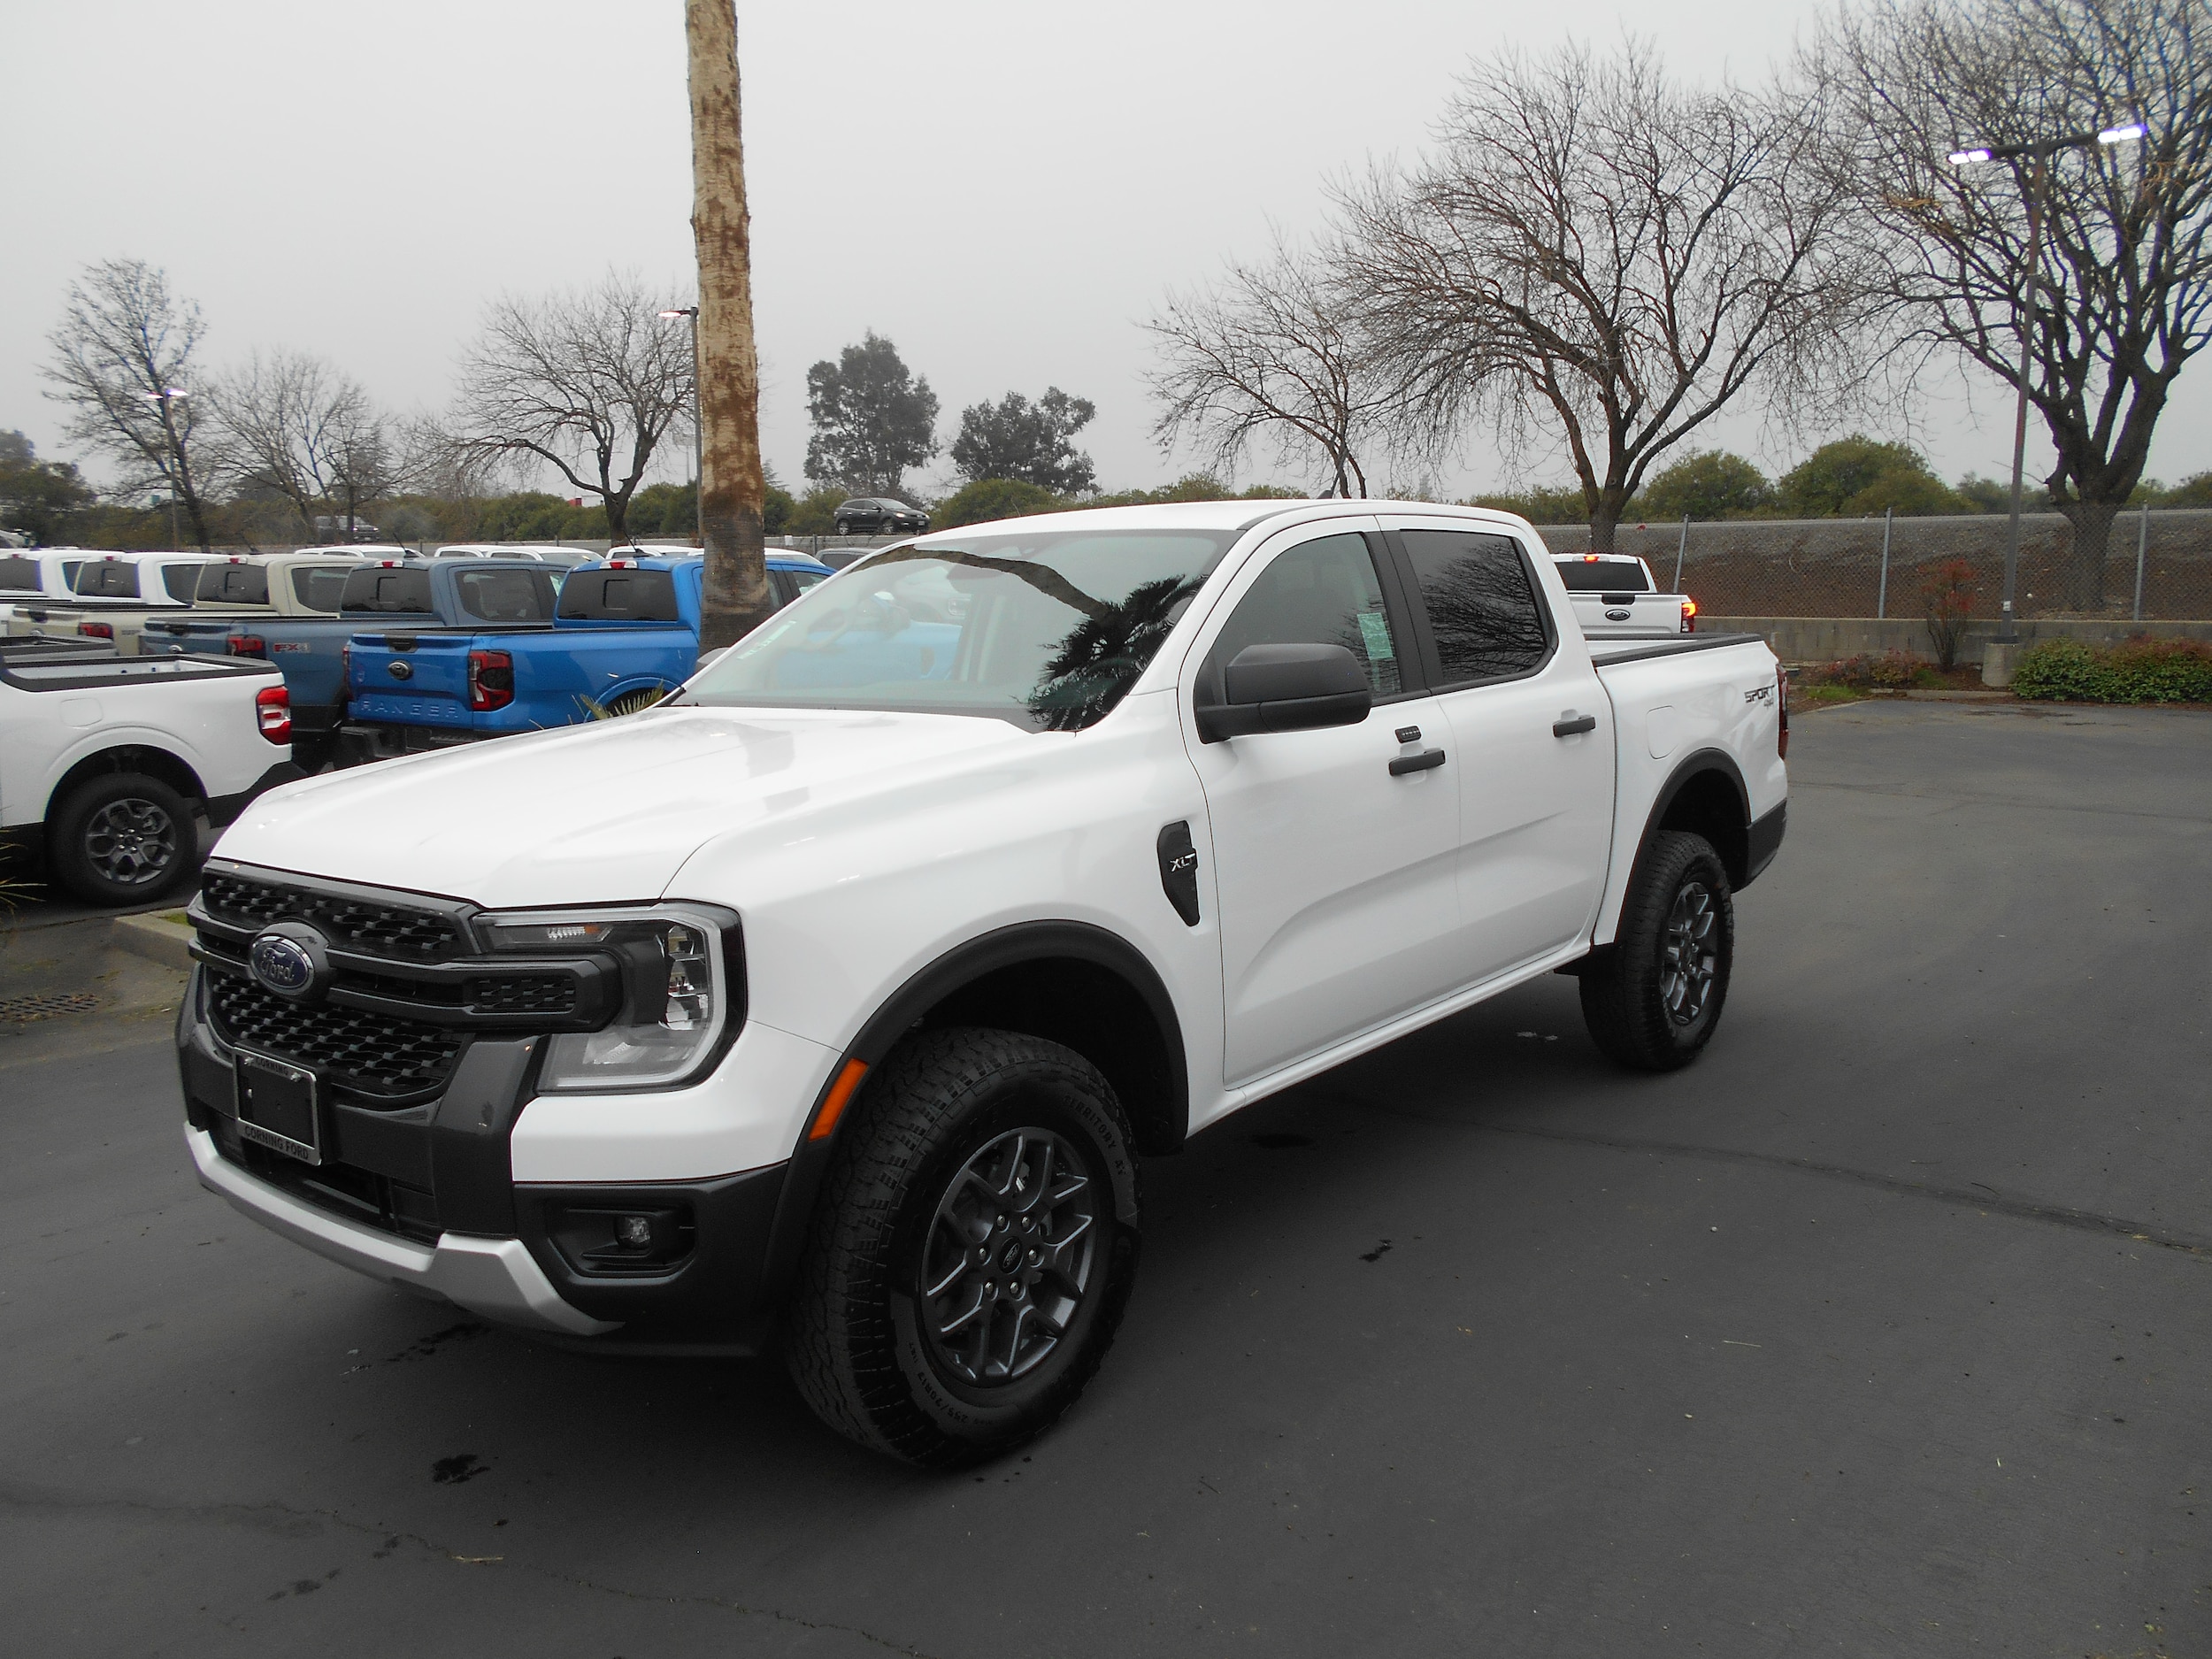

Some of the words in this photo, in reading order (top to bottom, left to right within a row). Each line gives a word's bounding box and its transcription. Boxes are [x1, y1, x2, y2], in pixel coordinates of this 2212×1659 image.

[1744, 685, 1775, 703] SPORT
[361, 700, 459, 718] RANGER
[1170, 853, 1195, 872] XLT
[260, 947, 296, 982] Ford
[245, 1125, 282, 1148] CORNING
[286, 1141, 309, 1160] FORD
